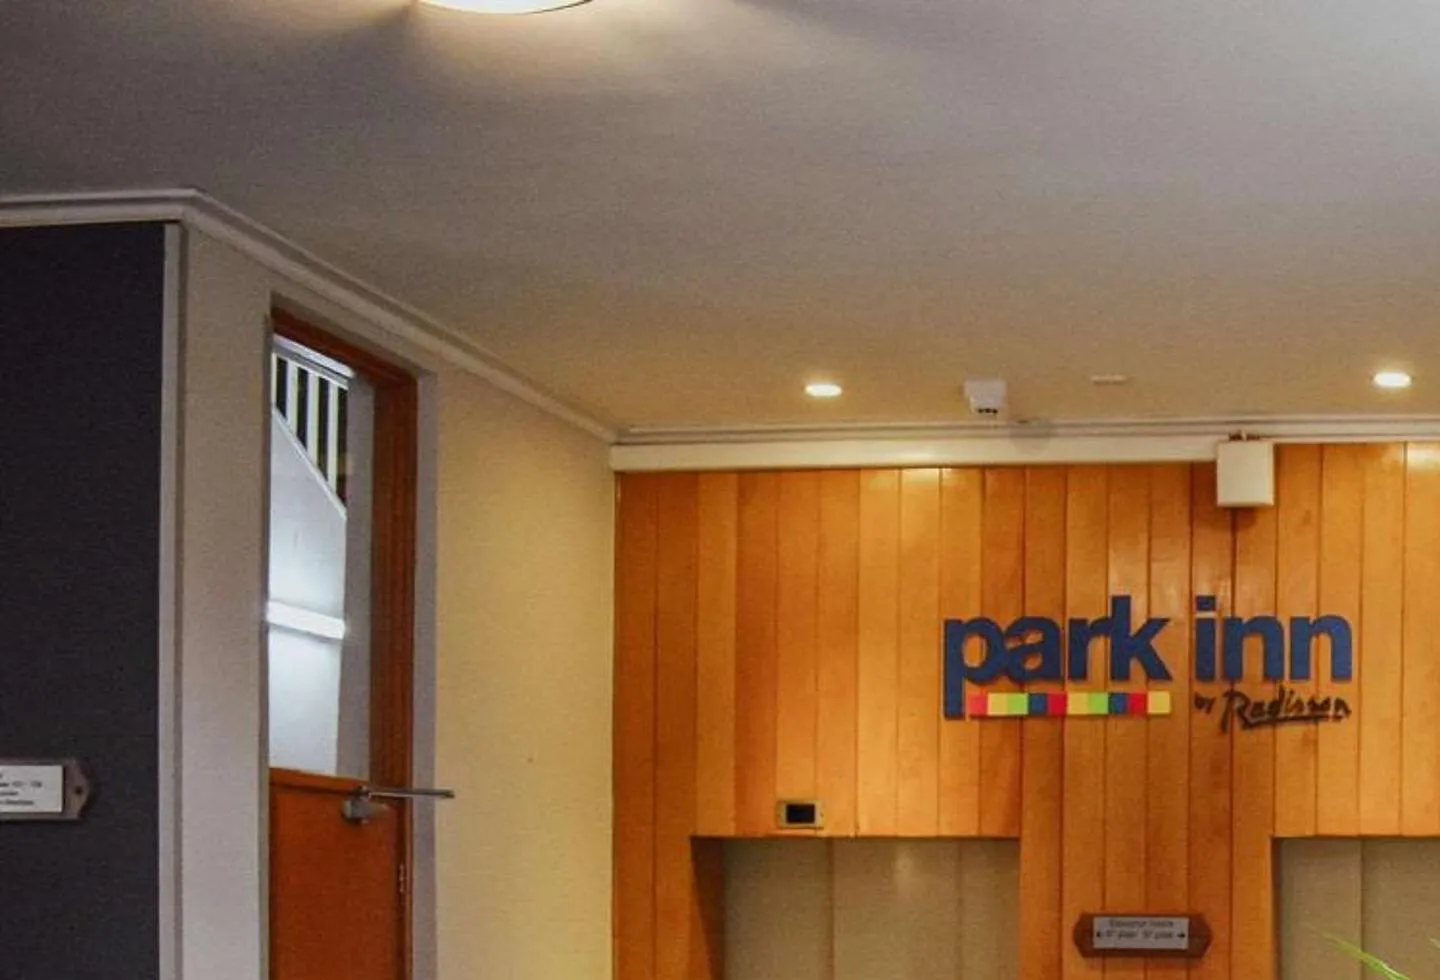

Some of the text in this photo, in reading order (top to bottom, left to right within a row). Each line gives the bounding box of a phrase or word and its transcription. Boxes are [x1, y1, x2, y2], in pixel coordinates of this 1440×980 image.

[944, 595, 1353, 718] park inn
[1194, 684, 1352, 733] by Radisson
